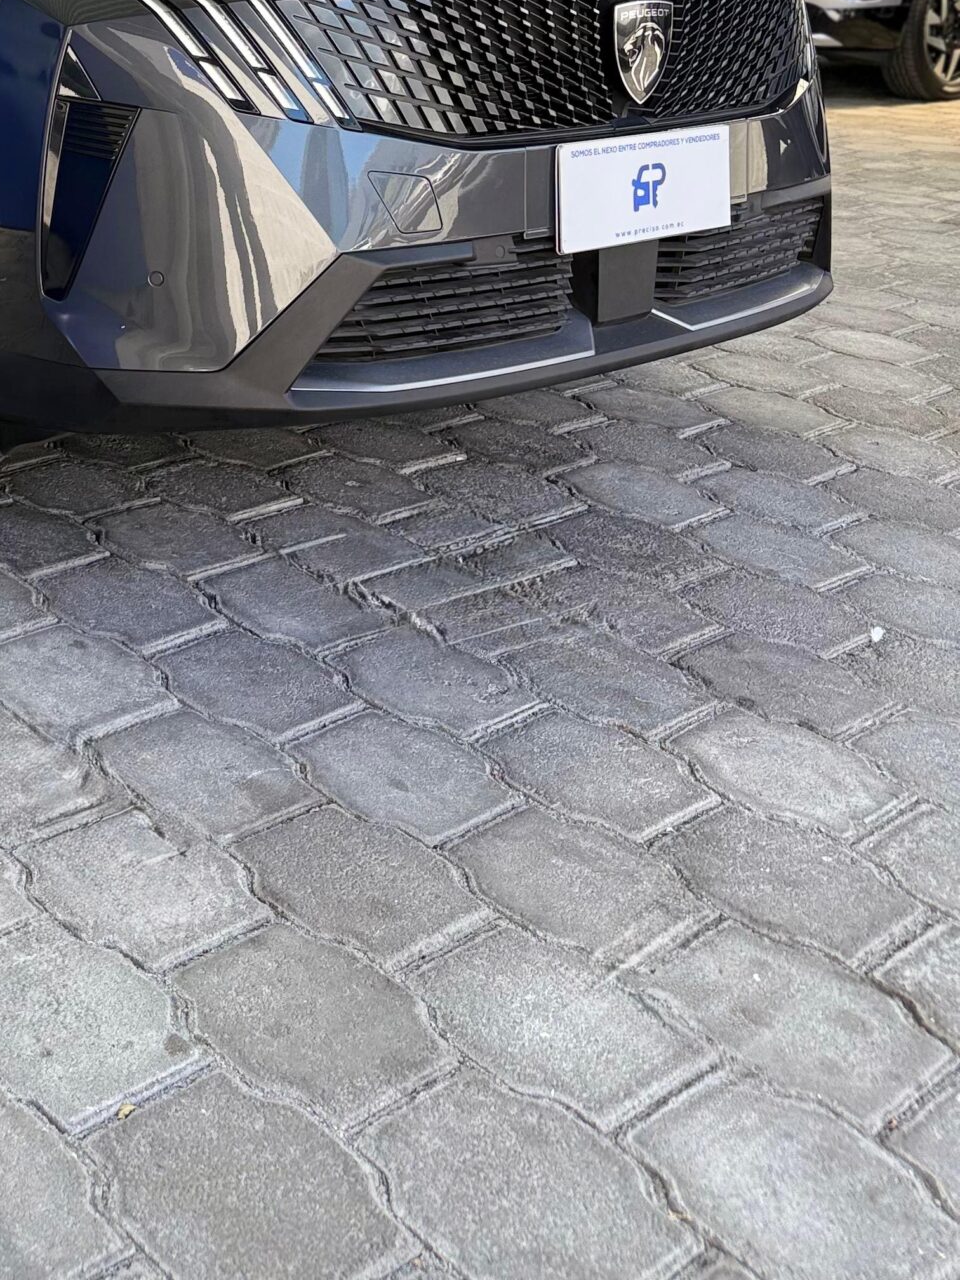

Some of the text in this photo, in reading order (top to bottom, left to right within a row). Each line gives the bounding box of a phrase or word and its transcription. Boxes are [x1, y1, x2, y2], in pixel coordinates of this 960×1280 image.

[620, 8, 670, 21] PEUGEOT
[570, 148, 593, 158] SOMOS
[593, 147, 601, 156] EL
[601, 145, 618, 155] NEXO
[618, 143, 637, 153] ENTRE
[637, 138, 680, 151] COMPRADORES
[684, 133, 721, 145] VENDEDORES
